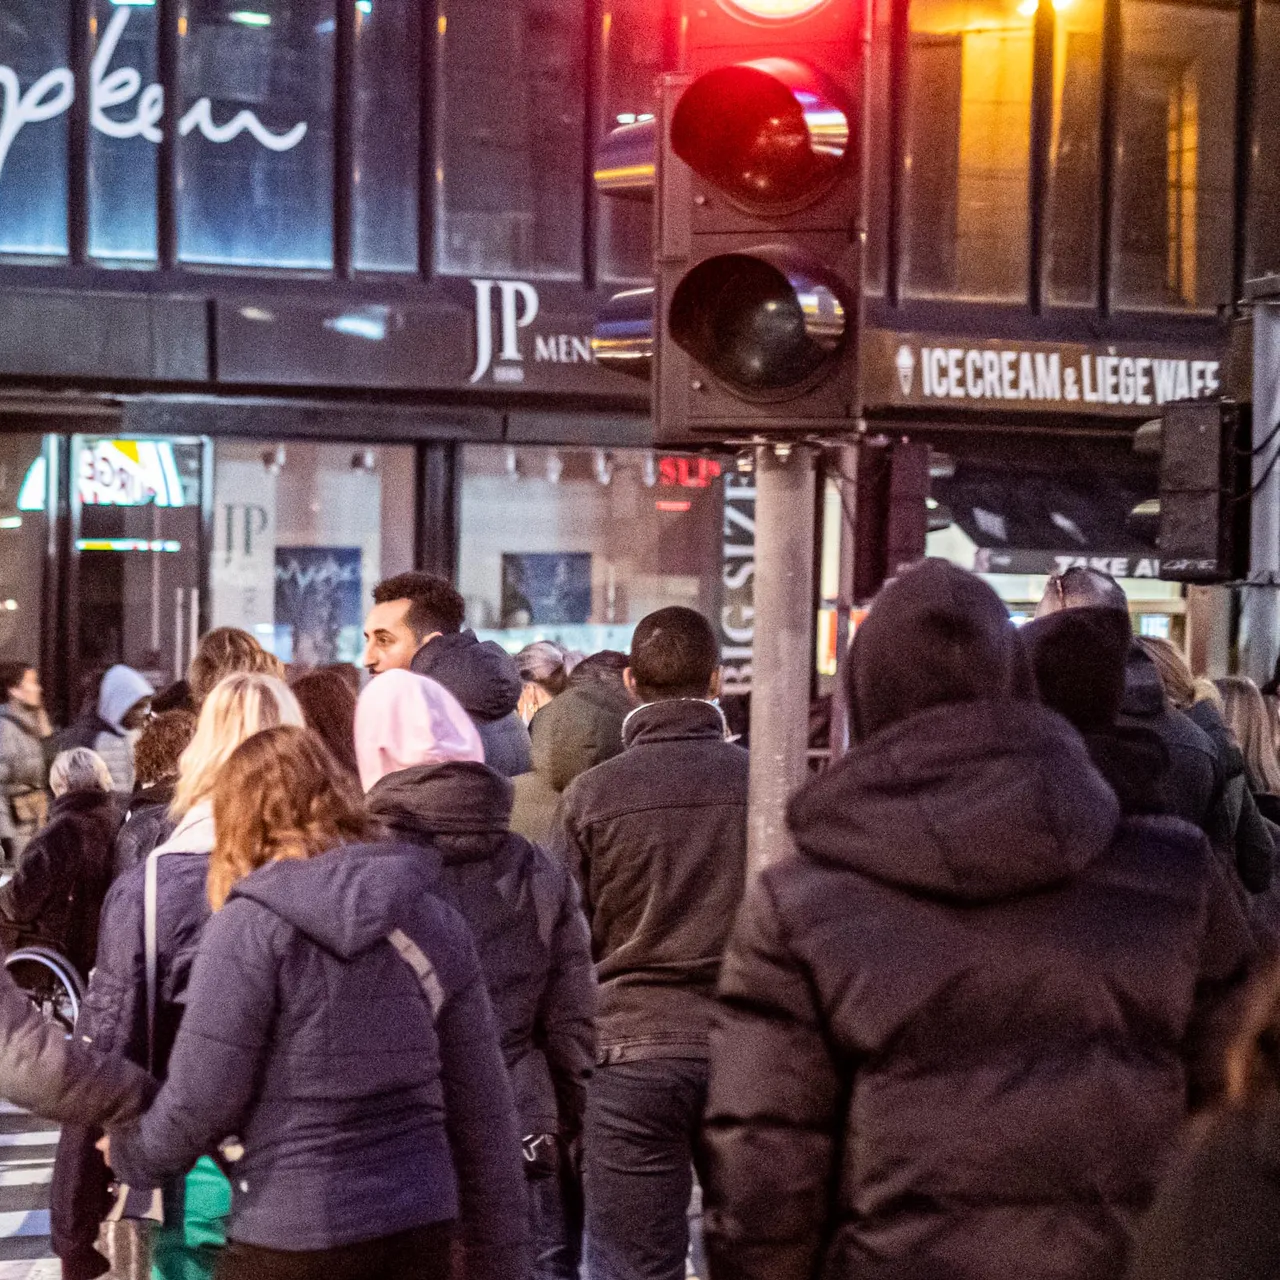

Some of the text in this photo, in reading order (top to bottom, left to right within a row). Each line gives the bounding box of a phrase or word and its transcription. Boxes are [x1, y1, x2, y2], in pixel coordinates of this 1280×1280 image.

[470, 279, 593, 384] JP MEN
[1064, 366, 1080, 401] &
[1081, 345, 1153, 405] LIÈGE
[224, 503, 269, 566] JP
[719, 472, 758, 696] BIG SIZE
[1054, 555, 1129, 576] TAKE
[1133, 558, 1161, 578] A
